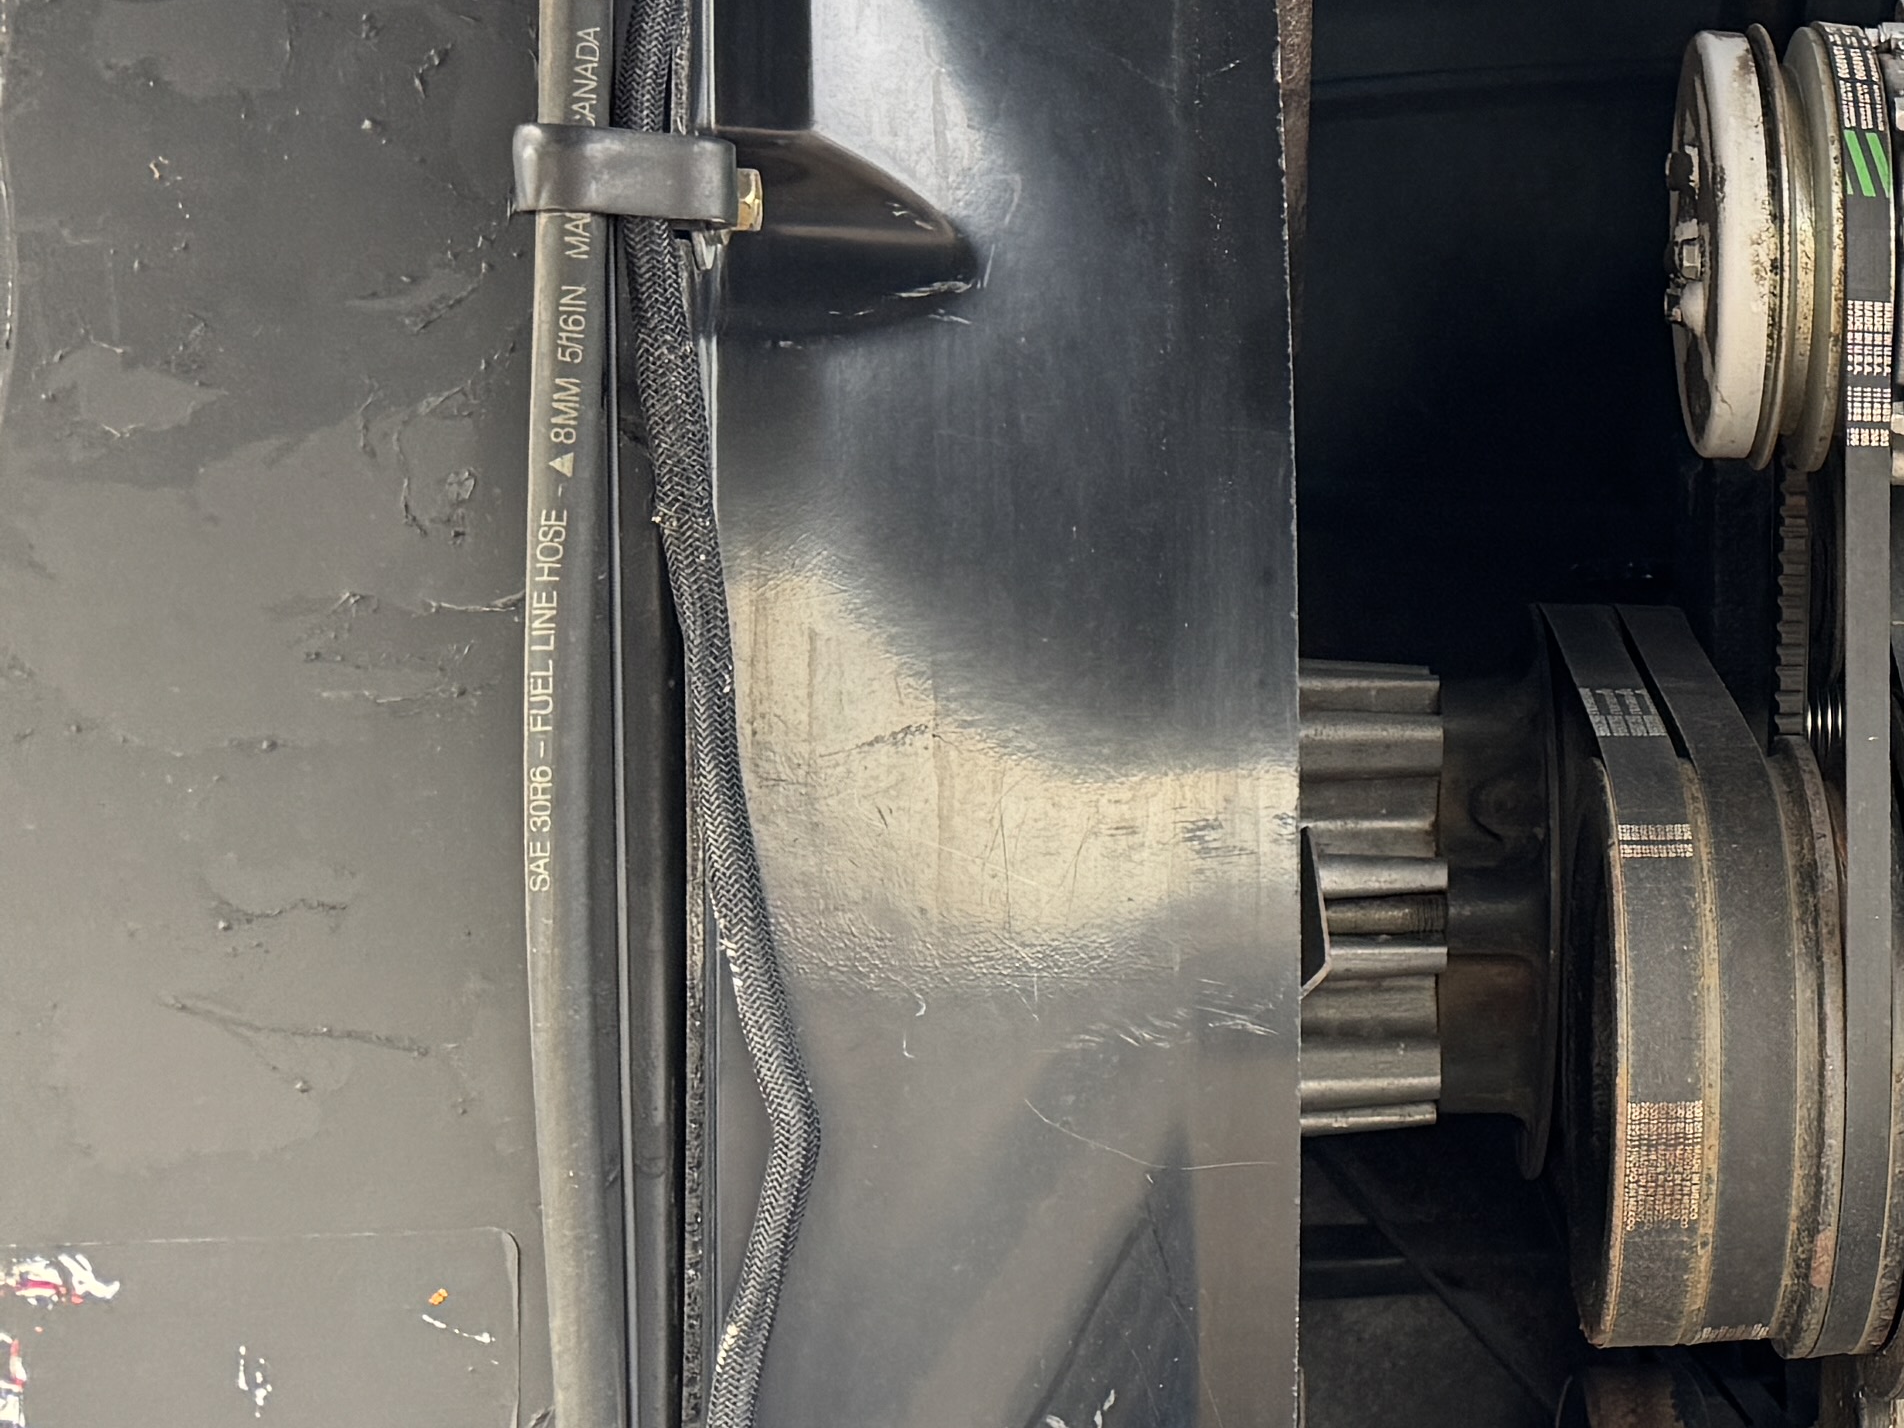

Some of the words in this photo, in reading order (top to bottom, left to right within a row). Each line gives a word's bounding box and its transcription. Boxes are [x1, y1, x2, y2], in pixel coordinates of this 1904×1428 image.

[535, 509, 568, 581] HOSE
[532, 591, 558, 650] LINE
[530, 660, 554, 732] FUEL
[529, 766, 553, 832] 30R6
[530, 841, 551, 892] SAE
